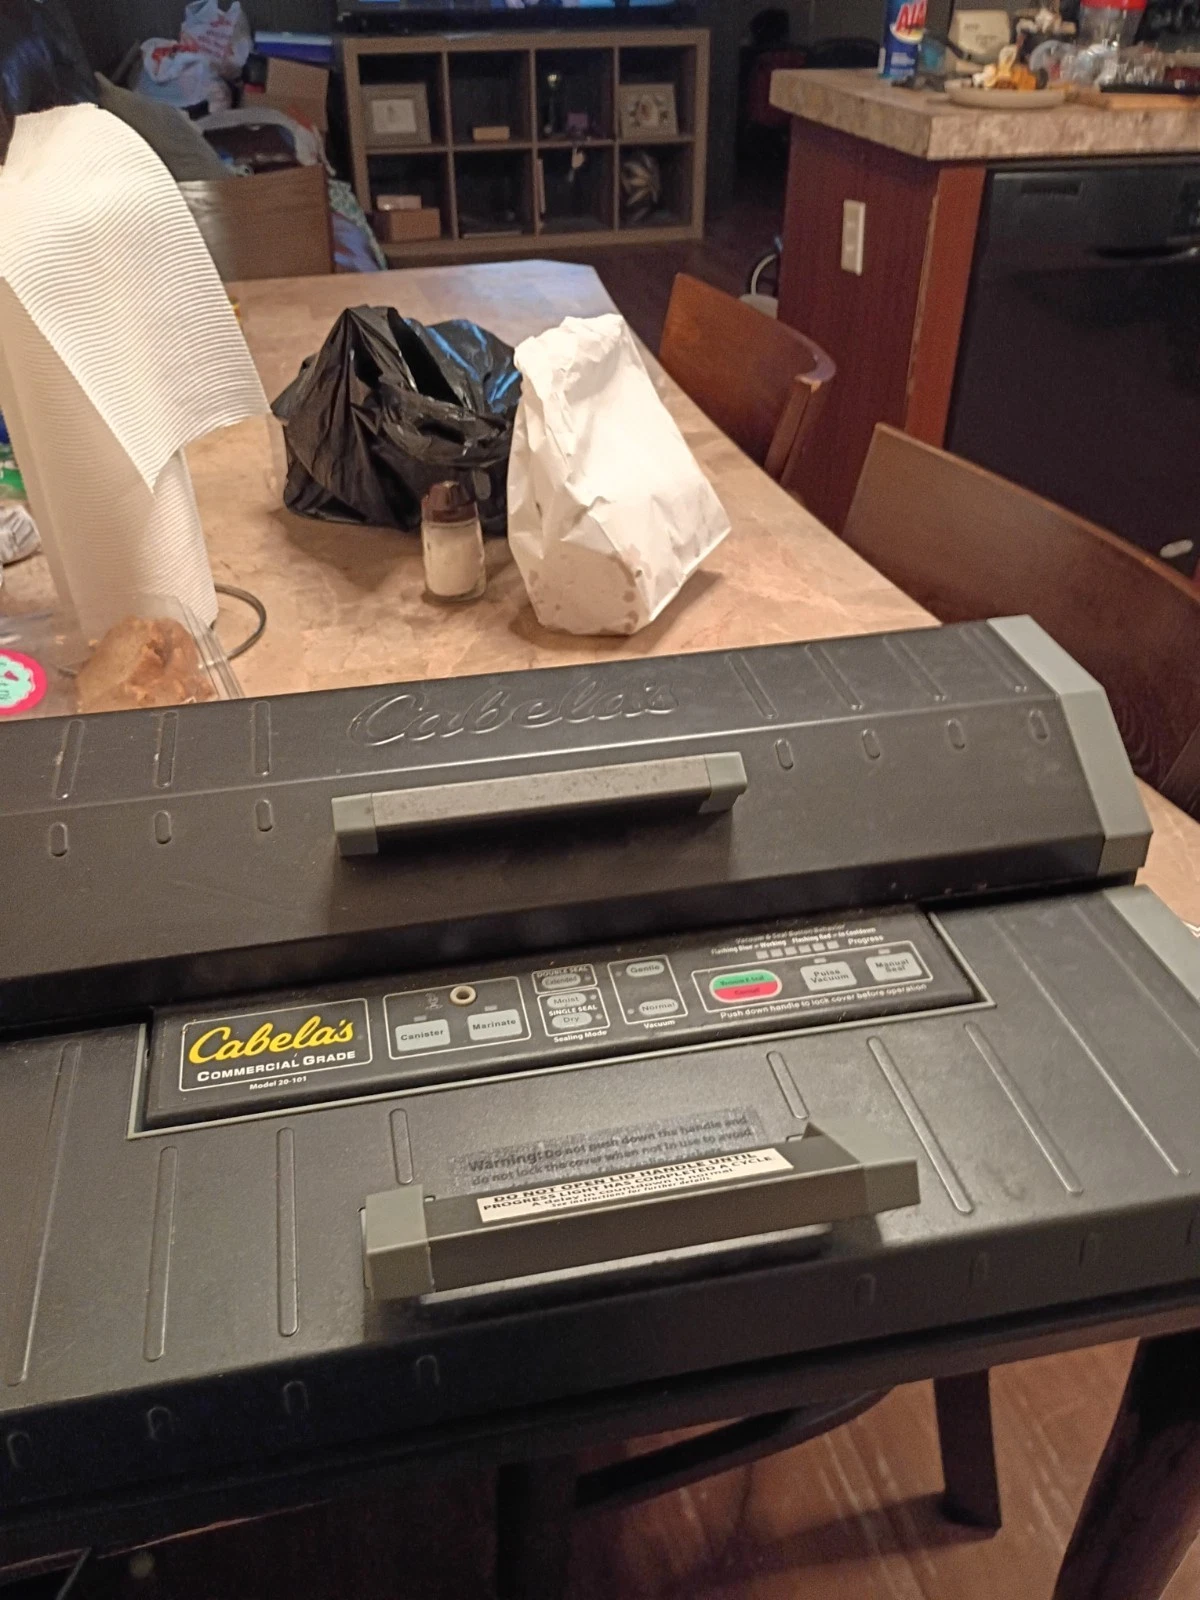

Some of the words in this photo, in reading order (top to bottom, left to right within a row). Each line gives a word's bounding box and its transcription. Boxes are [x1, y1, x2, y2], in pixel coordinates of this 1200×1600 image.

[348, 676, 679, 747] Cabela's
[847, 934, 884, 945] Progress
[630, 964, 661, 974] Gentle
[875, 958, 910, 969] Manual
[885, 965, 906, 973] Seal
[536, 968, 569, 978] DOUBLE
[570, 965, 588, 973] SEAL
[813, 969, 841, 977] Pulse
[545, 975, 578, 986] Extended
[810, 973, 849, 984] Vacuum
[553, 996, 579, 1004] Moist
[642, 1001, 676, 1012] Normal
[720, 1009, 744, 1019] Push
[745, 1006, 769, 1015] down
[770, 1002, 800, 1011] handle
[812, 996, 830, 1006] lock
[831, 994, 855, 1002] cover
[856, 990, 885, 999] before
[886, 983, 927, 995] operation
[548, 1007, 577, 1016] SINGLE
[577, 1004, 598, 1012] SEAL
[472, 1018, 517, 1031] Marinate
[643, 1018, 677, 1029] Vacuum
[188, 1015, 354, 1064] Cabela's
[400, 1029, 445, 1041] Canister
[553, 1033, 584, 1043] Sealing
[584, 1030, 607, 1038] Mode
[197, 1058, 299, 1082] COMMERCIAL
[303, 1050, 356, 1066] GRADE
[249, 1080, 277, 1090] Model
[278, 1075, 307, 1086] 20-101
[545, 1149, 562, 1159] Do
[566, 1144, 586, 1156] not
[588, 1139, 620, 1153] push
[621, 1131, 656, 1145] down
[658, 1126, 678, 1138] the
[679, 1120, 722, 1135] handle
[725, 1113, 748, 1126] and
[472, 1175, 490, 1186] do
[492, 1171, 514, 1183] not
[516, 1166, 543, 1178] lock
[544, 1161, 568, 1172] the
[569, 1155, 603, 1167] cover
[604, 1149, 640, 1165] when
[641, 1143, 663, 1155] not
[664, 1141, 677, 1150] in
[679, 1137, 701, 1148] use
[703, 1134, 717, 1144] to
[718, 1127, 753, 1141] avoid
[483, 1194, 556, 1210] PROGRESS
[559, 1186, 600, 1197] LIGHT
[603, 1179, 633, 1189] HAS
[634, 1164, 716, 1184] COMPLETED
[731, 1155, 773, 1167] CYCLE
[494, 1193, 518, 1203] DO
[523, 1187, 558, 1198] NOT
[561, 1179, 605, 1191] OPEN
[609, 1172, 636, 1183] LID
[639, 1160, 706, 1177] HANDLE
[708, 1152, 758, 1165] UNTIL
[547, 1195, 582, 1206] delay
[599, 1178, 672, 1196] countdown
[688, 1167, 734, 1180] normal
[569, 1190, 626, 1204] instructions
[644, 1181, 677, 1192] further
